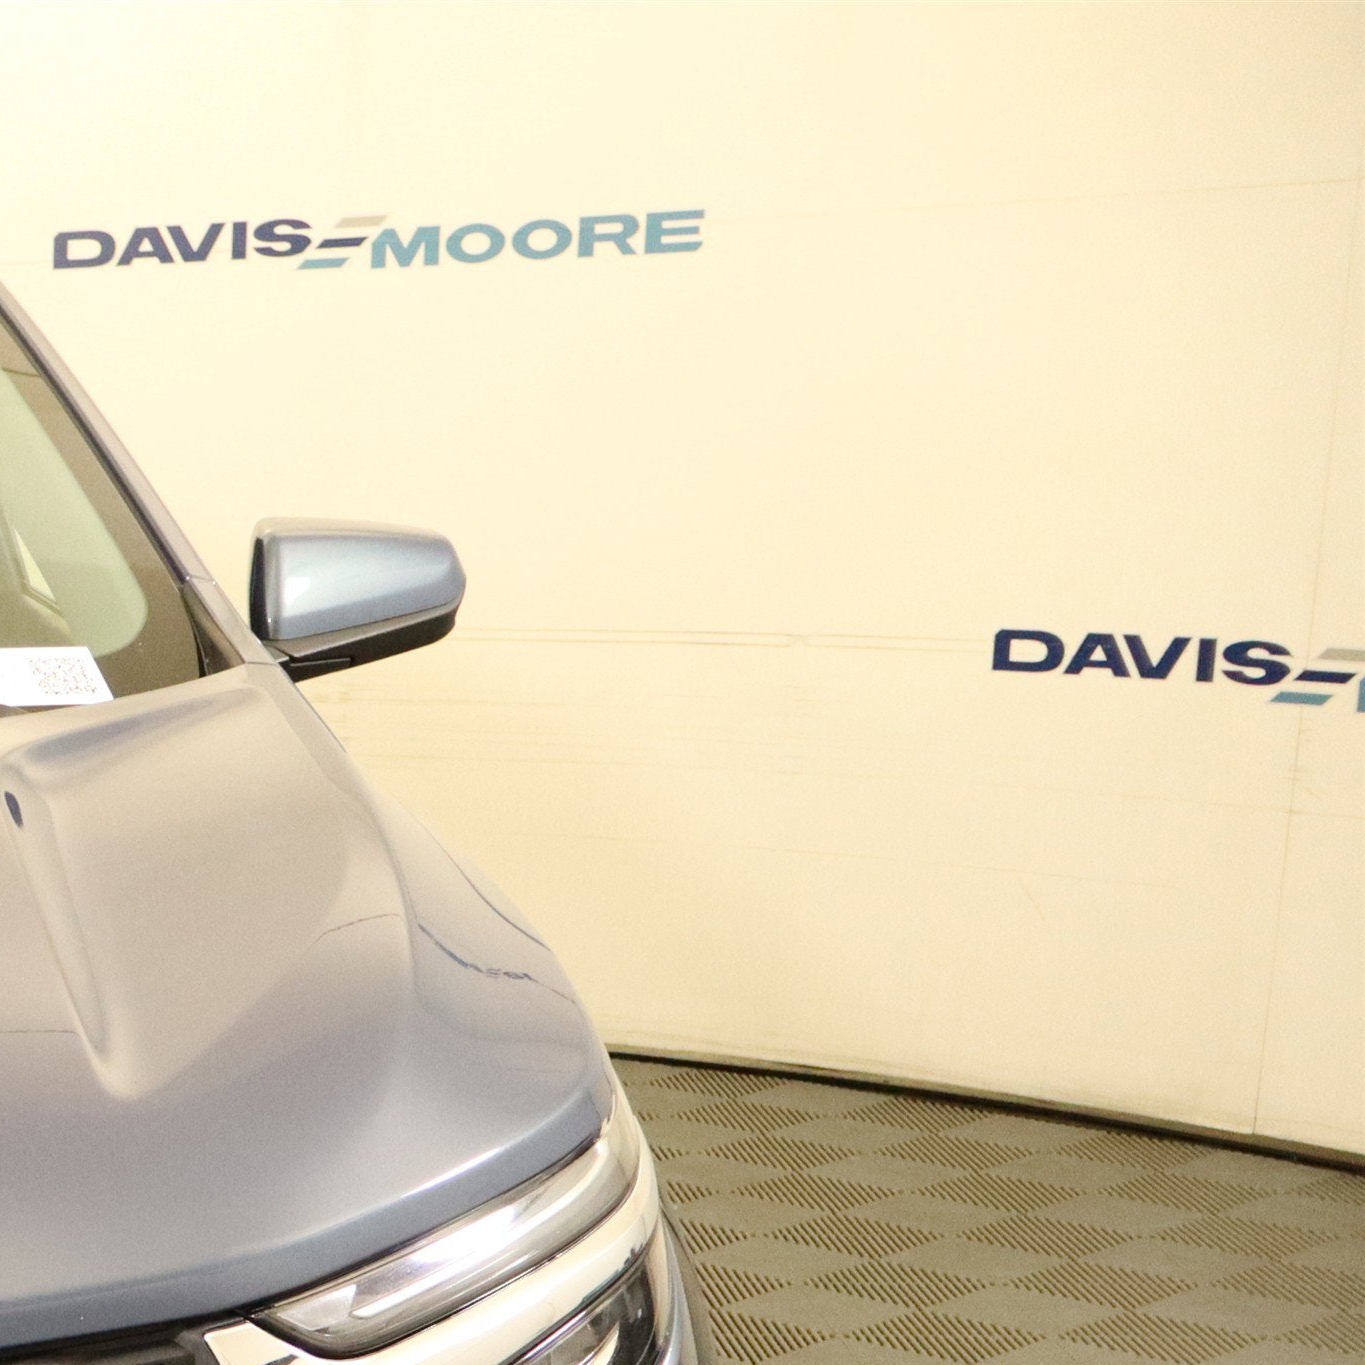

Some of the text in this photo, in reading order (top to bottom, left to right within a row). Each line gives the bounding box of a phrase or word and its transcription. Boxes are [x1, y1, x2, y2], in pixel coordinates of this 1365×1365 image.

[53, 210, 703, 269] DAVIS MOORE
[991, 628, 1292, 686] DAVIS
